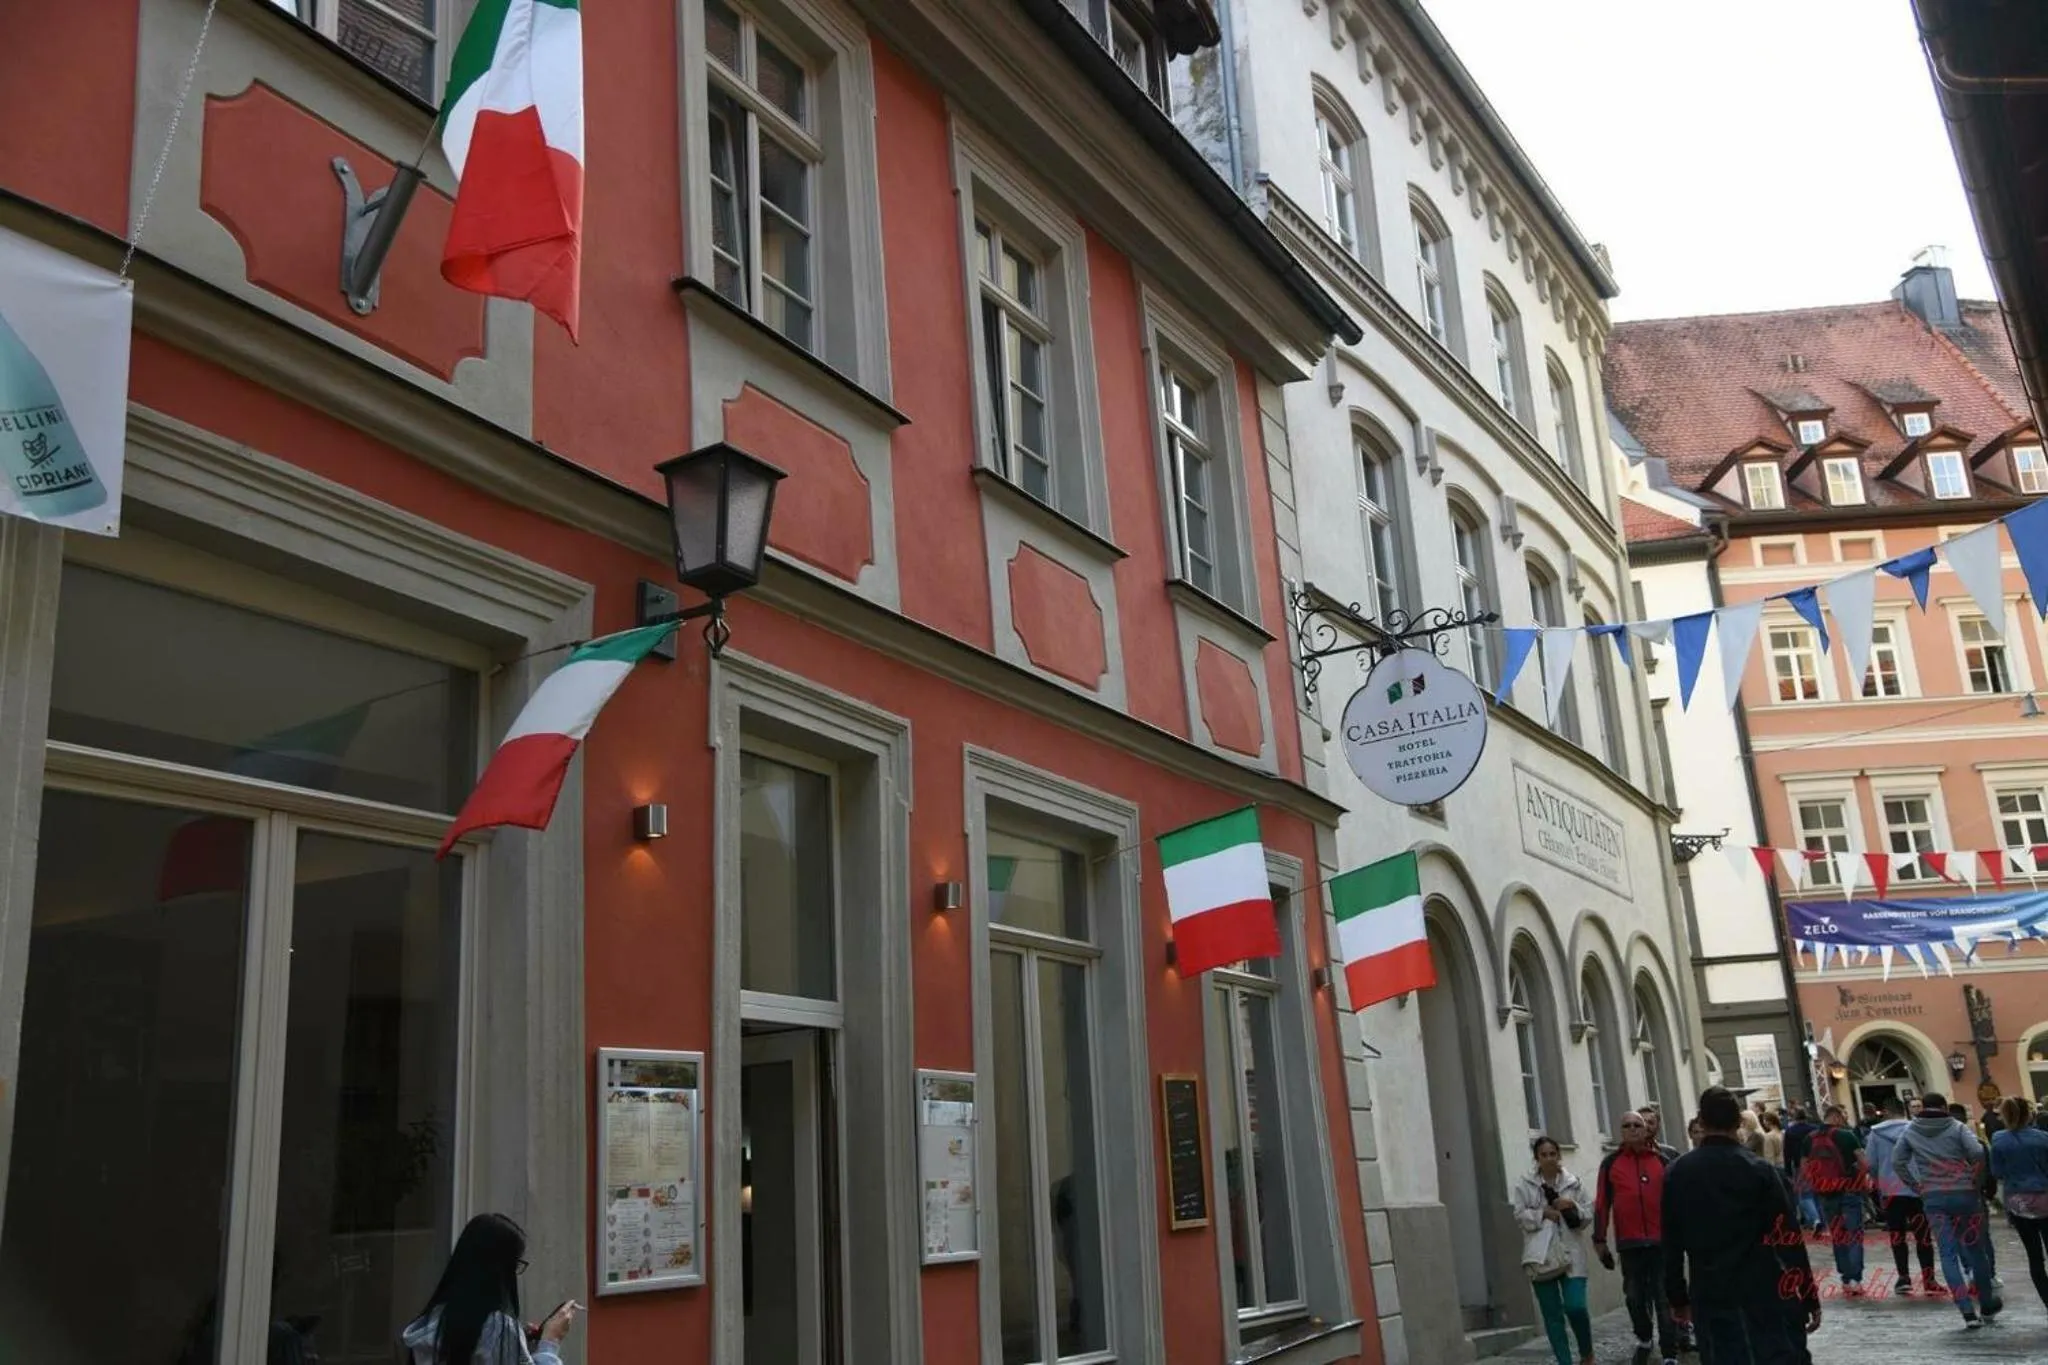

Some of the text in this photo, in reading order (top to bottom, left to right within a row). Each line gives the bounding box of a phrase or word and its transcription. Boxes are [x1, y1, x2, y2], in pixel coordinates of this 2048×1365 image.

[0, 412, 63, 432] ELLINI
[16, 462, 90, 489] CIPRIANI
[1347, 701, 1480, 742] CASA ITALIA
[1398, 737, 1436, 753] HOTEL
[1387, 750, 1452, 770] TRATTORIA
[1395, 766, 1448, 783] PIZZERIA
[1803, 925, 1839, 936] ZELO
[1744, 1057, 1775, 1069] Hotel
